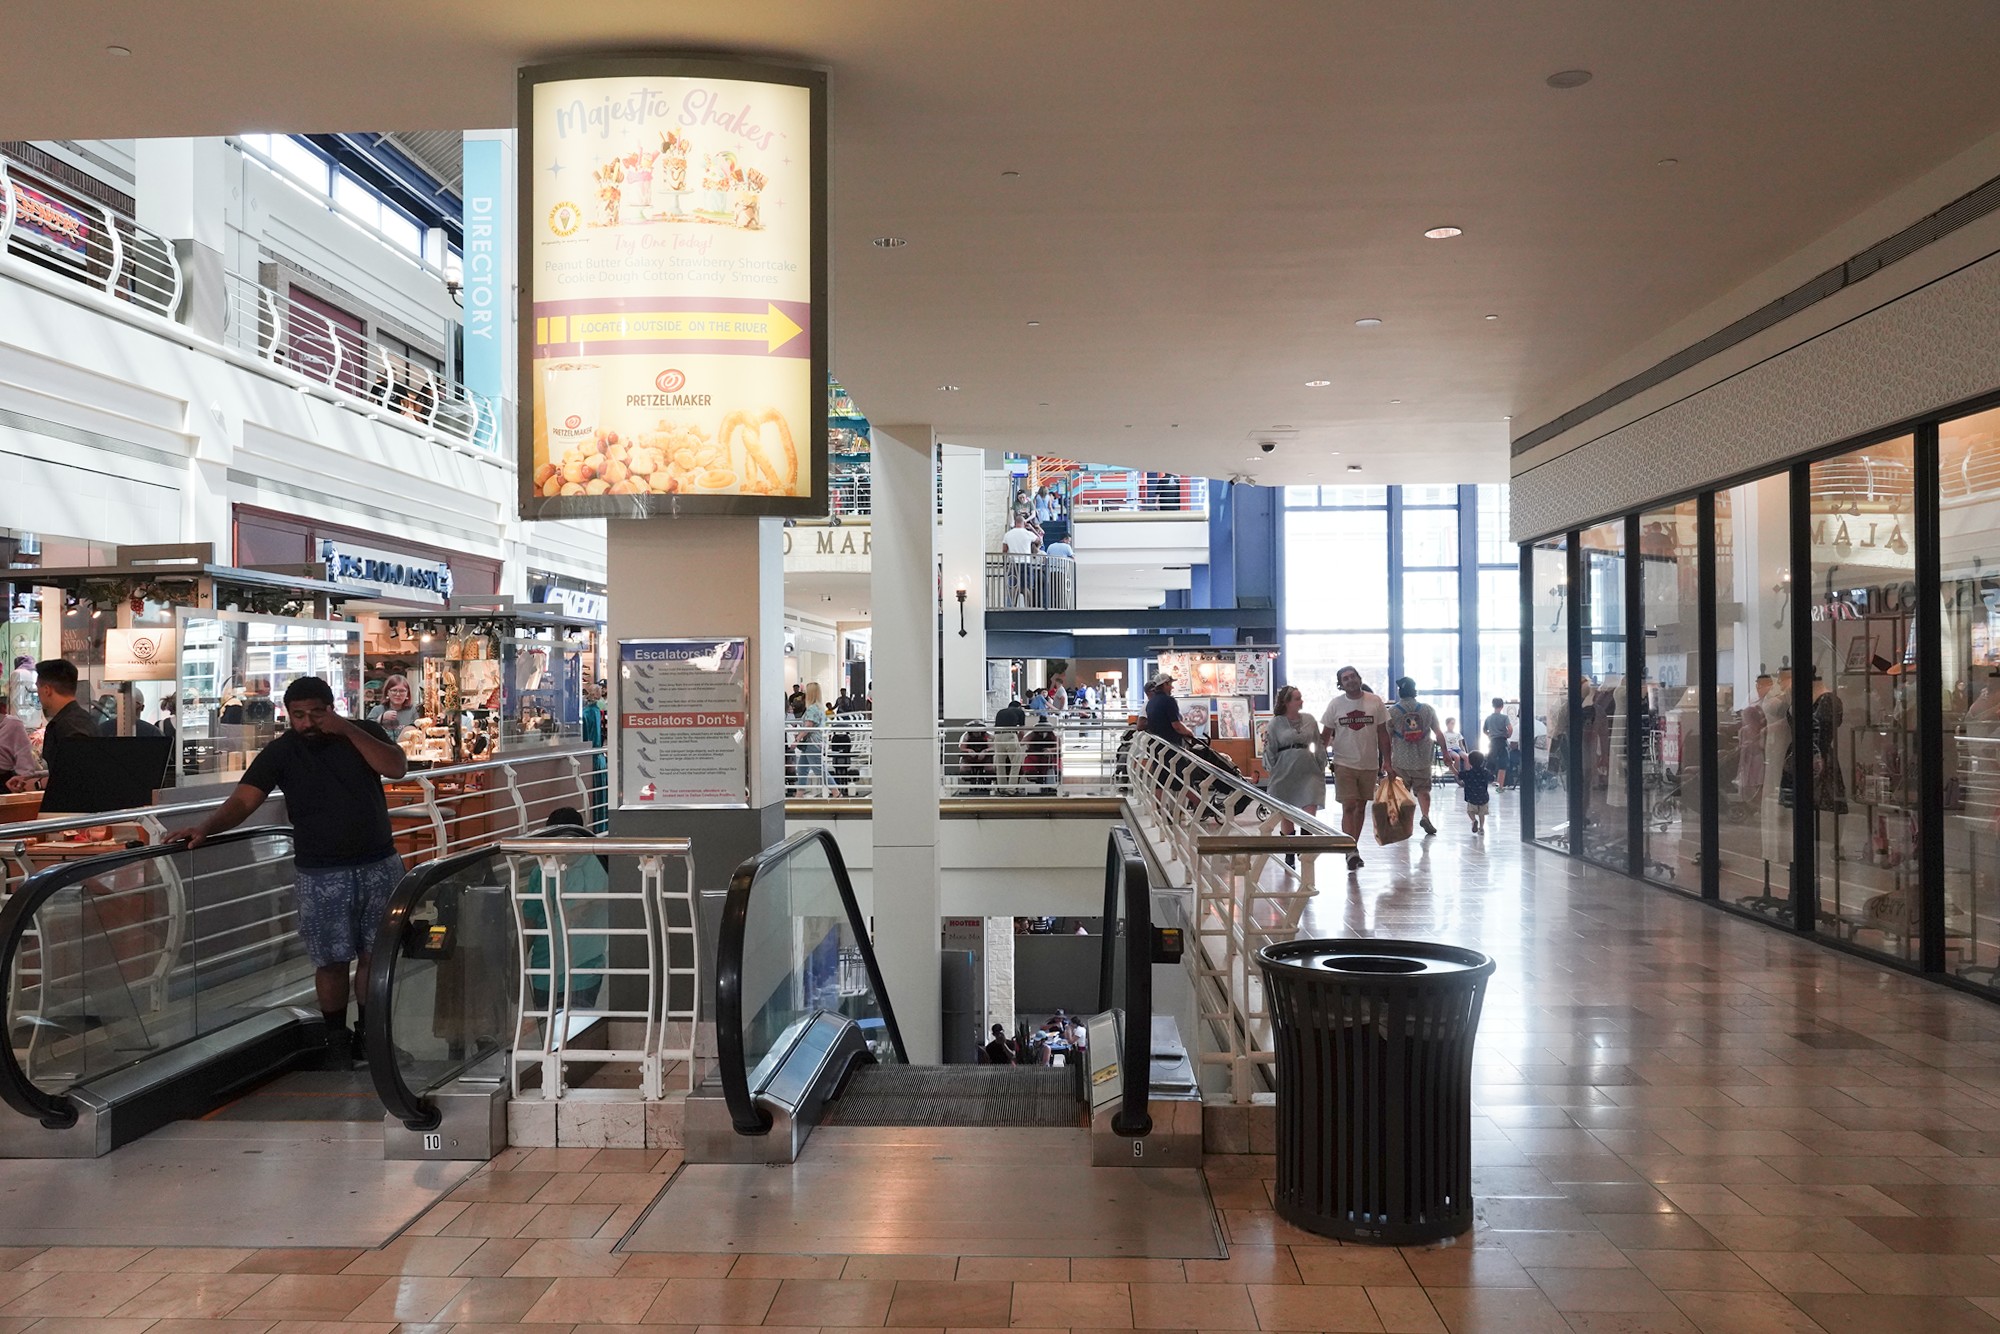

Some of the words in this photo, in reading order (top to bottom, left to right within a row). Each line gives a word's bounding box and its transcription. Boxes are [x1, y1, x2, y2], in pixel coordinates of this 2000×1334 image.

[557, 88, 670, 140] Majestic
[614, 233, 637, 255] Try
[641, 233, 667, 249] One
[672, 233, 713, 255] Today!
[472, 197, 493, 340] DIRECTORY
[545, 260, 583, 272] Peanut
[586, 257, 621, 269] Butter
[624, 256, 665, 269] Galaxy
[669, 256, 735, 271] Strawberry
[738, 257, 797, 273] Shortcake
[557, 273, 596, 285] Cookie
[599, 271, 638, 284] Dough
[643, 270, 684, 281] Cotton
[687, 270, 726, 284] Candy
[633, 320, 682, 332] OUTSIDE
[688, 320, 705, 332] ON
[709, 321, 731, 332] THE
[734, 322, 768, 334] RIVER
[626, 394, 712, 407] PRETZELMAKER
[635, 648, 701, 660] Escalators
[628, 715, 693, 726] Escalators
[697, 714, 737, 725] Don'ts
[426, 1135, 440, 1149] 10
[1135, 1142, 1142, 1156] 9
